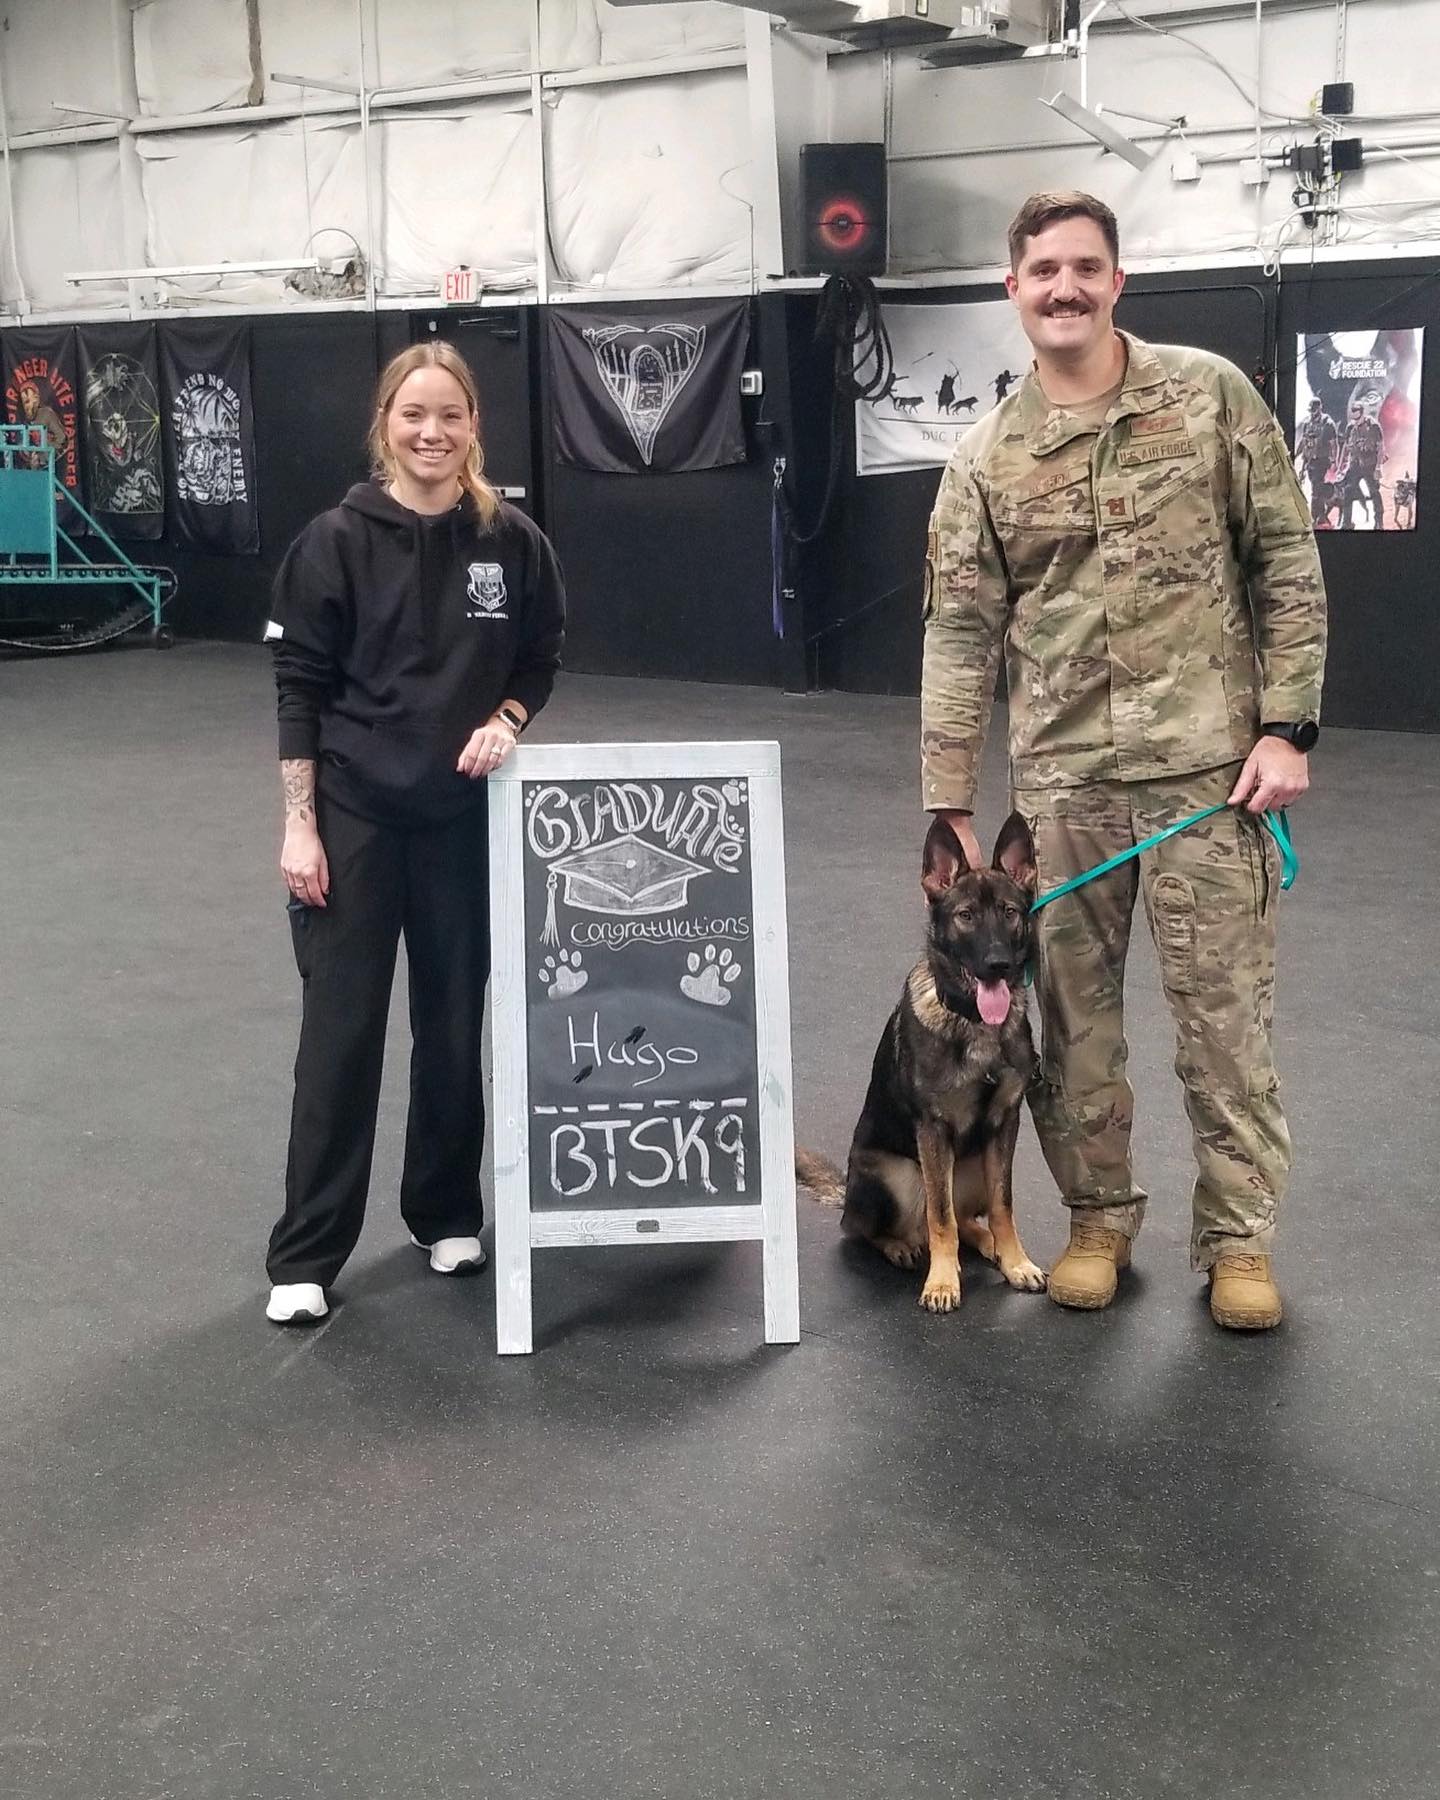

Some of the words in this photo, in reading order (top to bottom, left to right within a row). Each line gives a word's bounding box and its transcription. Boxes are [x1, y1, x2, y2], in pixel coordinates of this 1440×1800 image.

[446, 273, 472, 300] EXIT
[1342, 361, 1372, 370] RESCUE
[1373, 360, 1385, 369] 22
[1342, 368, 1387, 379] FOUNDATION
[208, 373, 224, 391] NO
[232, 447, 248, 503] ENEMY
[1142, 446, 1159, 460] AIR
[1161, 440, 1194, 457] FORCE
[570, 916, 750, 946] congratulations
[567, 1011, 698, 1088] Hugo
